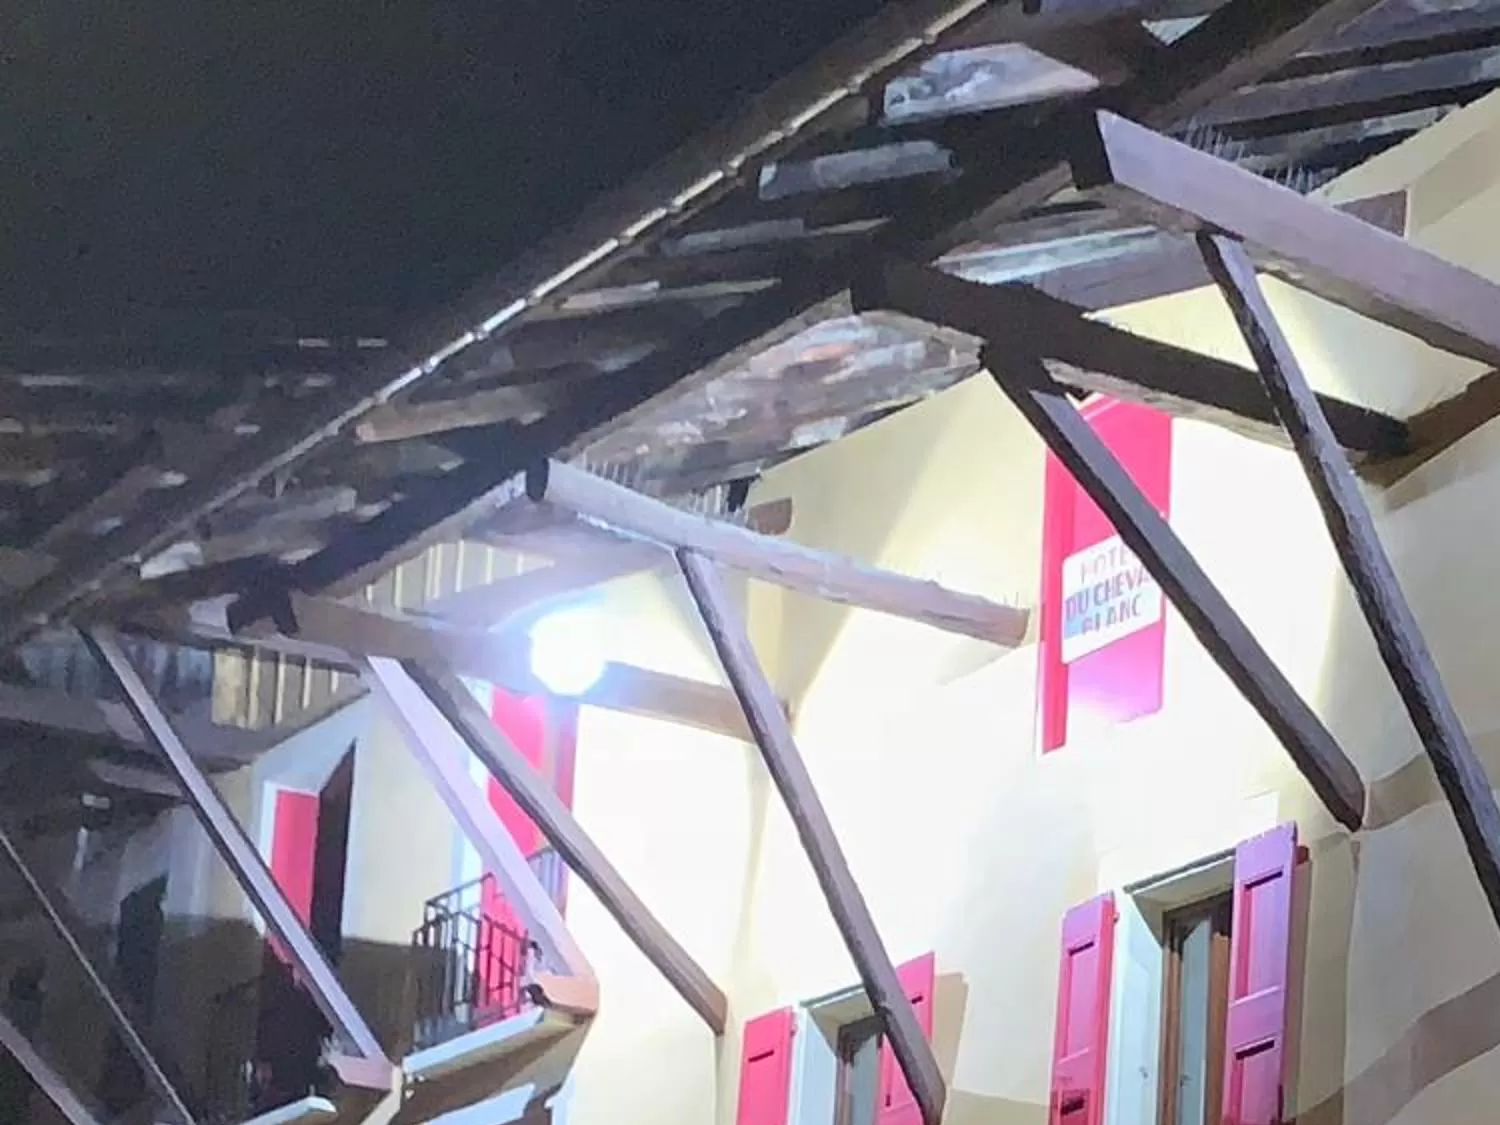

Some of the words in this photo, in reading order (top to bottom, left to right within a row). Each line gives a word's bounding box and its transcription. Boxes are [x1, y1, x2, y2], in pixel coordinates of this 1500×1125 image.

[1081, 544, 1130, 584] HOTE
[1066, 587, 1091, 621] DU
[1094, 567, 1150, 606] CHEVA
[1082, 593, 1141, 635] BLANC
